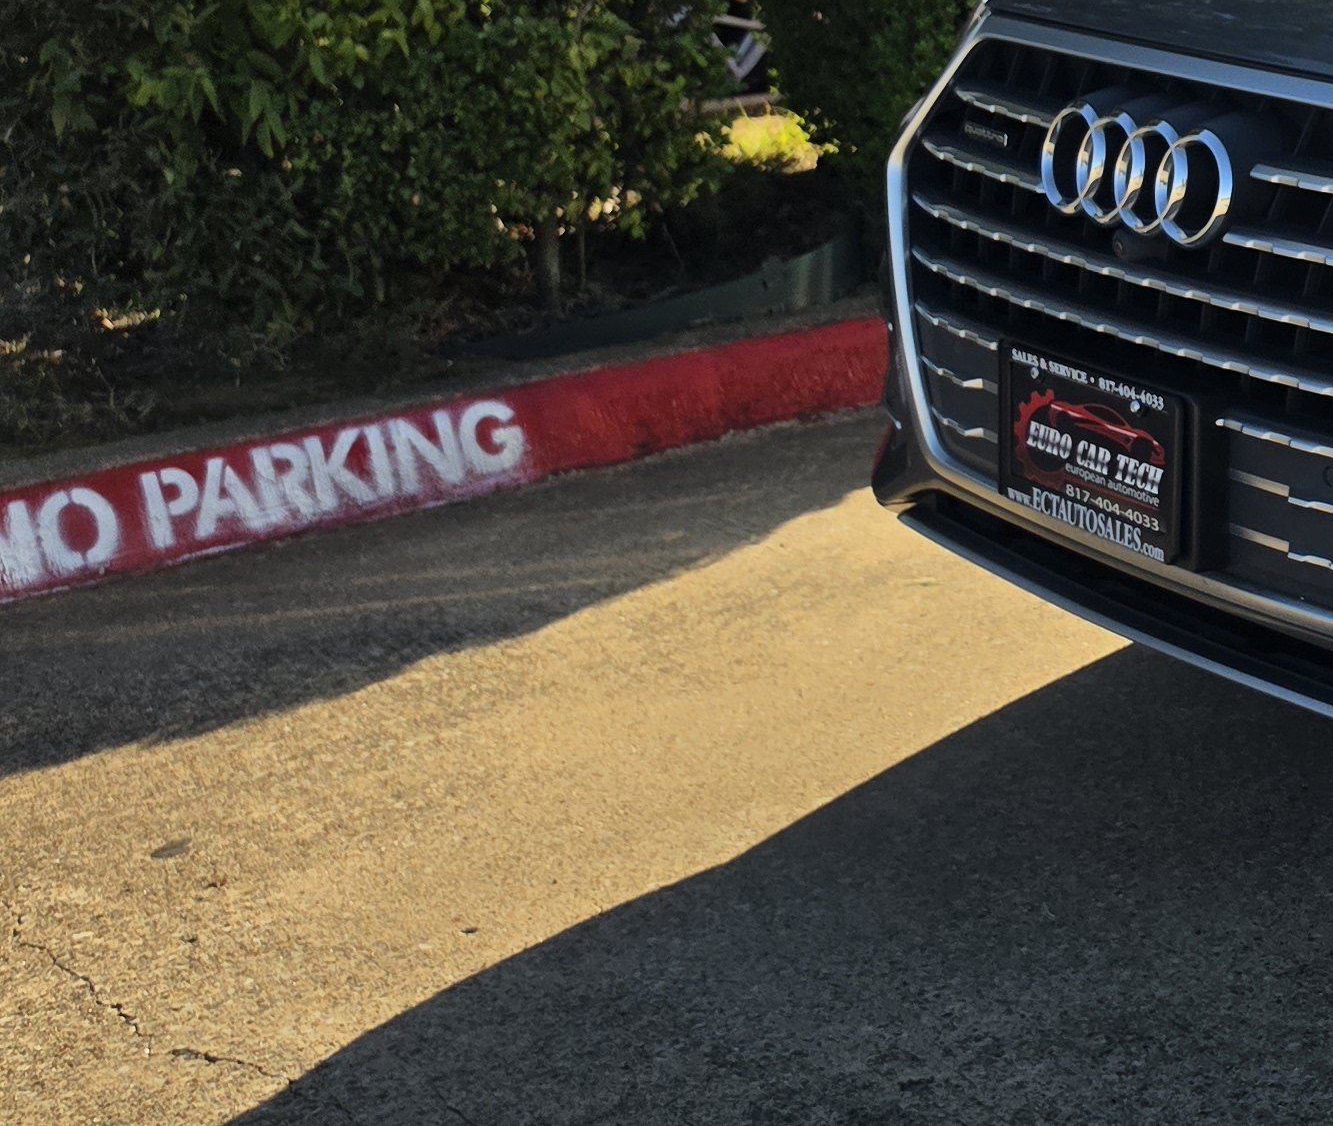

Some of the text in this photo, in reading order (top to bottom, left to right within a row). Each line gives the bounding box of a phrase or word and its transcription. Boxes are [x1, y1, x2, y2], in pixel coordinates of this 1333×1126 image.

[1012, 348, 1039, 365] SALES
[1049, 361, 1088, 384] SERVICE
[1098, 377, 1165, 411] 817-404-4033
[141, 400, 525, 550] PARKING
[1026, 420, 1164, 495] EURO CAR TECH
[1065, 462, 1160, 507] european automotive
[1007, 486, 1165, 562] www.ECTAUTOSALES.com
[1065, 483, 1160, 531] 817-404-4033
